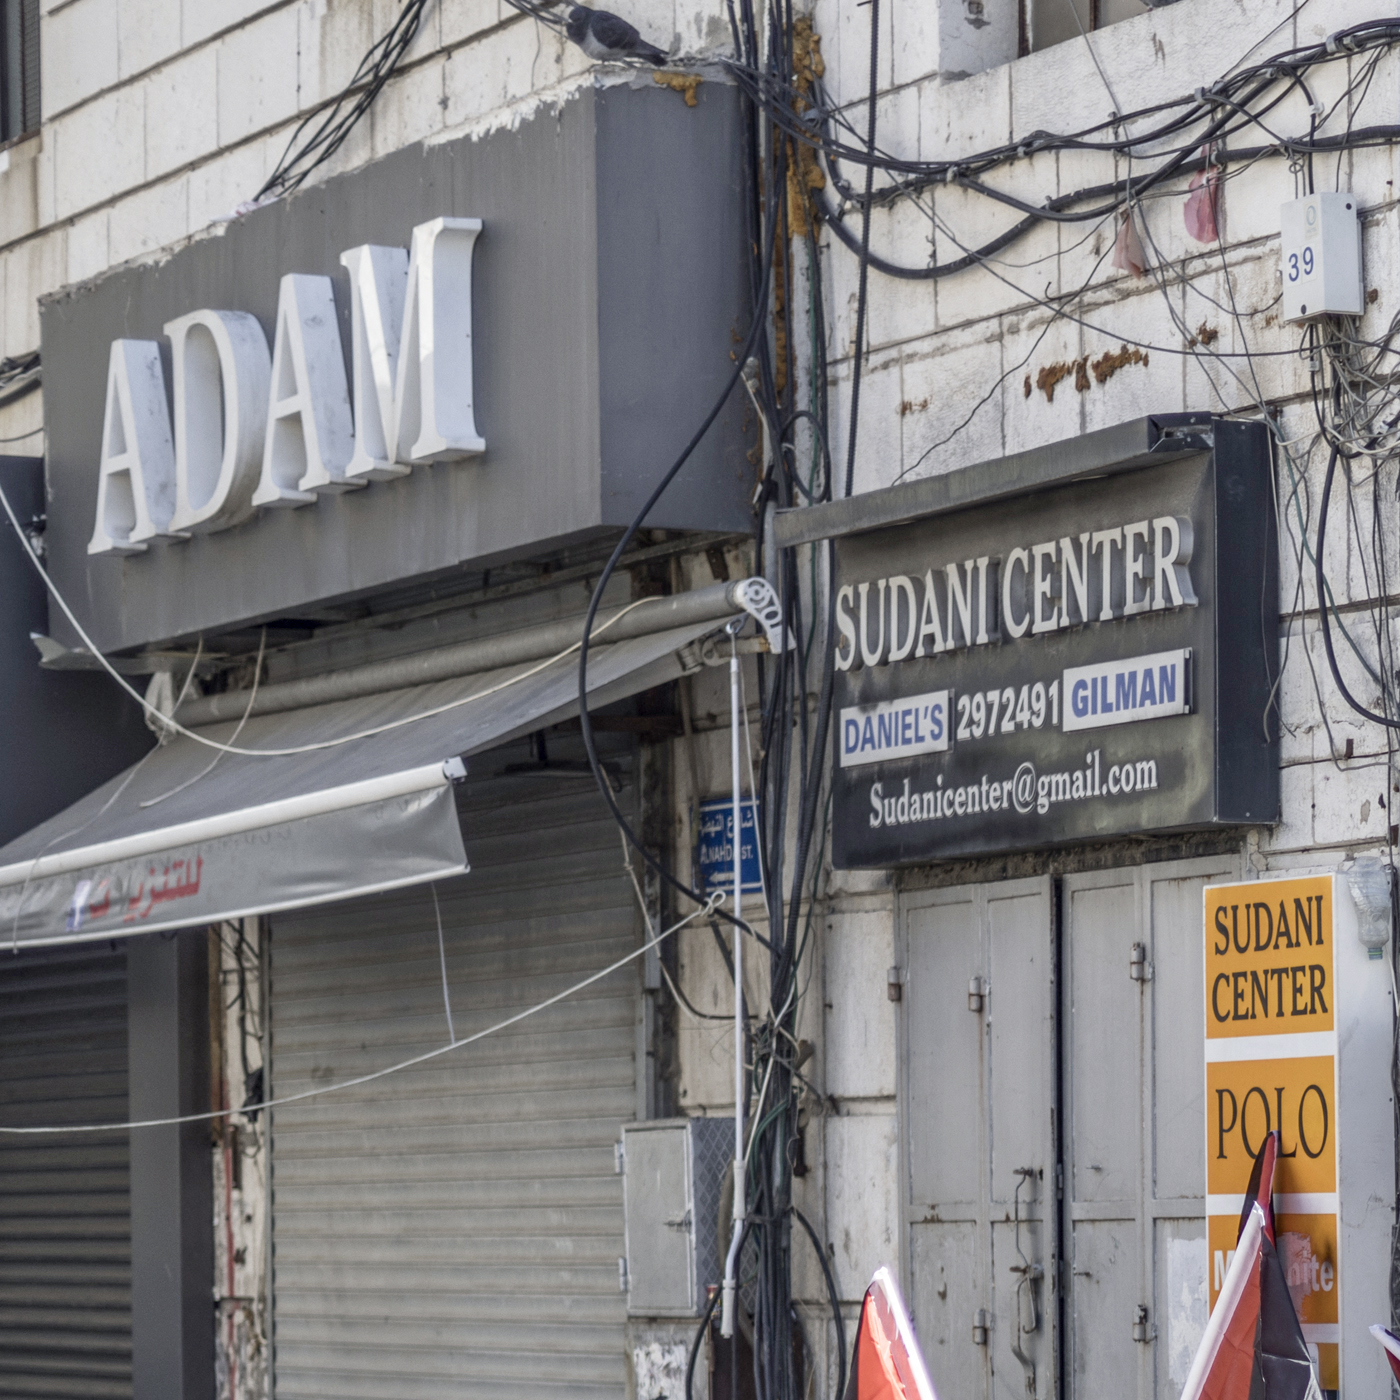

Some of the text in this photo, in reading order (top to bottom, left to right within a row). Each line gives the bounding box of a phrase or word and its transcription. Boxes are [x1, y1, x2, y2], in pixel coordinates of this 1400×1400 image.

[1288, 246, 1314, 282] 39
[87, 216, 487, 557] ADAM
[835, 515, 1196, 671] SUDANI CENTER
[844, 662, 1177, 754] DANIEL'S 2972491 GILMAN
[869, 749, 1158, 829] Sudanicenter@gmail.com
[1214, 895, 1324, 956] SUDANI
[1211, 963, 1328, 1023] CENTER
[1216, 1083, 1329, 1160] POLO
